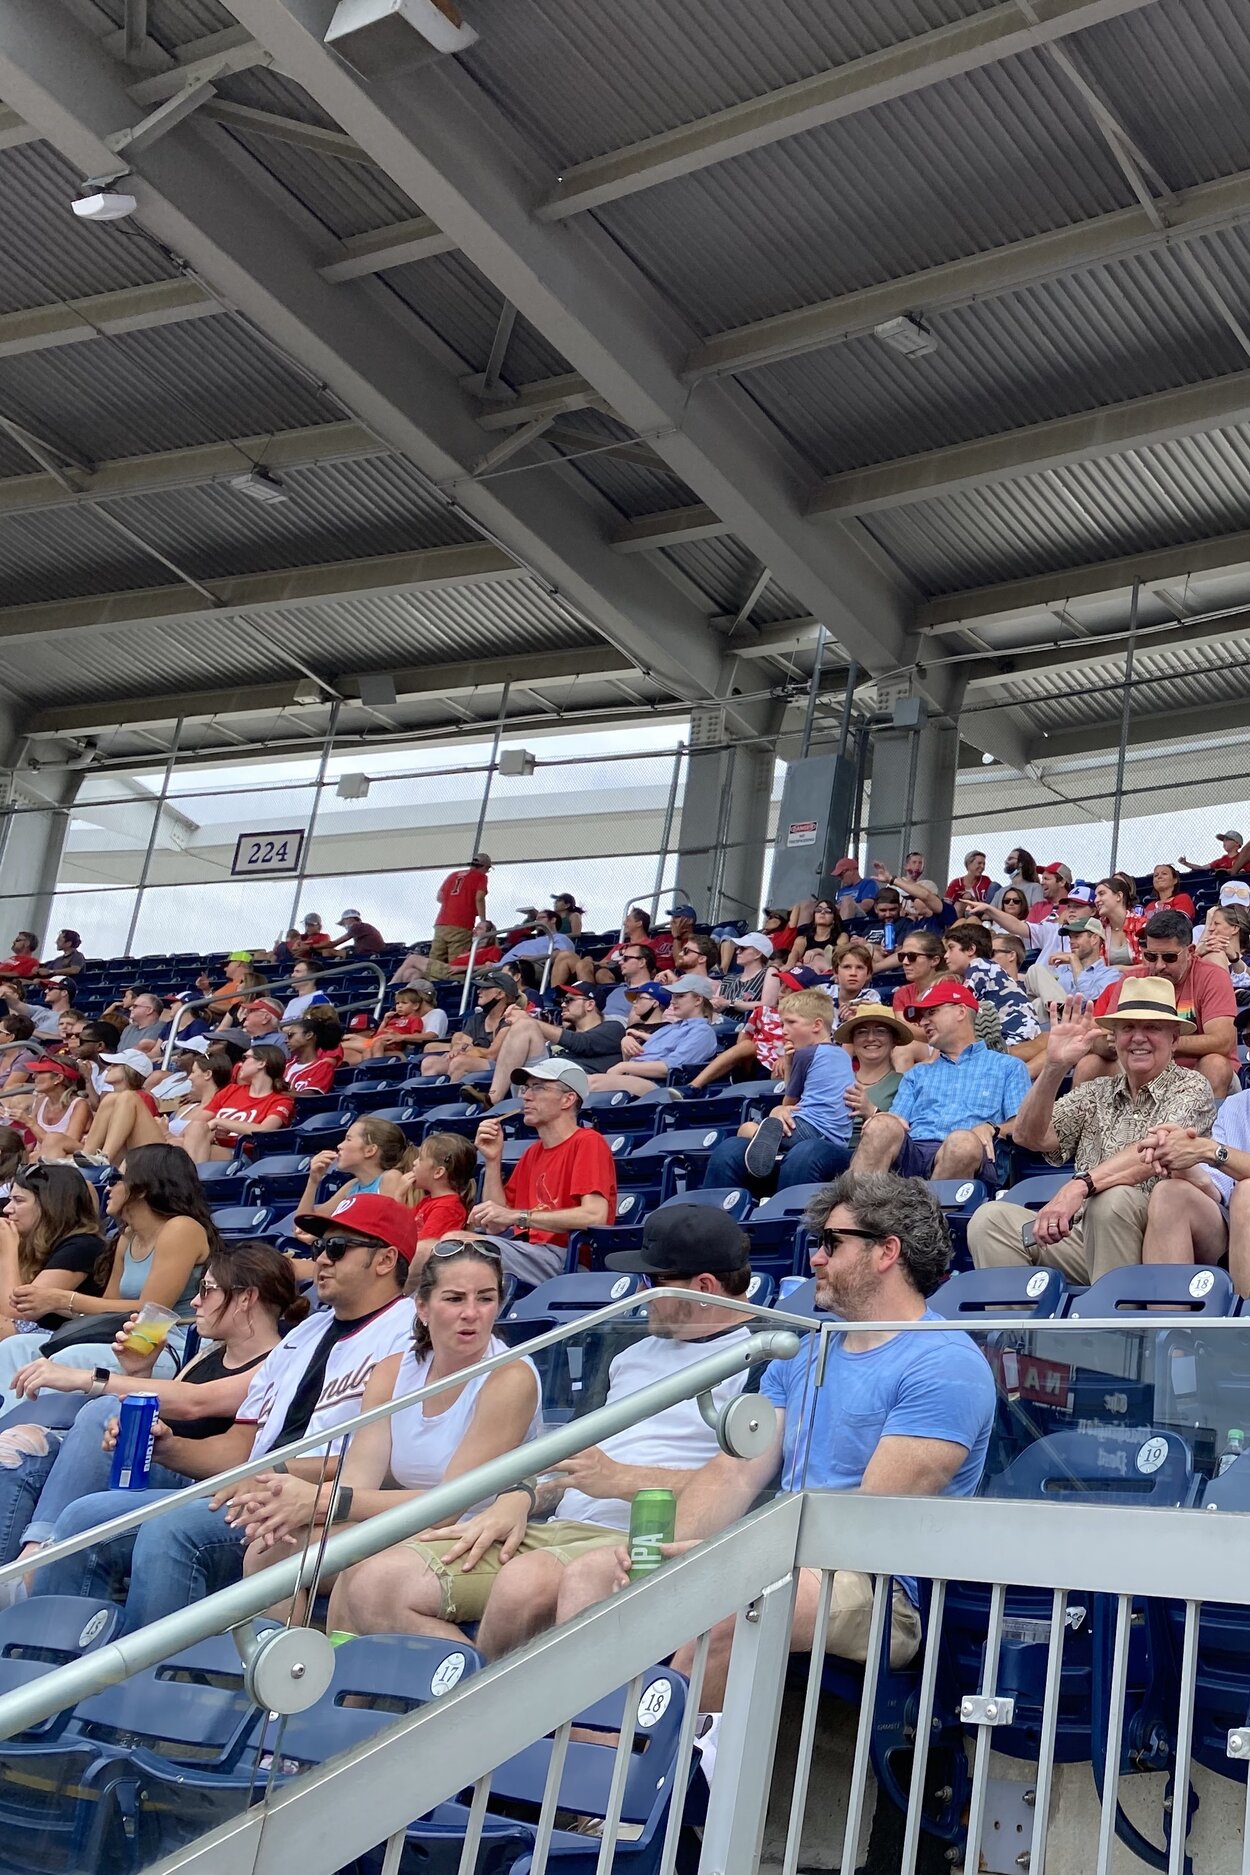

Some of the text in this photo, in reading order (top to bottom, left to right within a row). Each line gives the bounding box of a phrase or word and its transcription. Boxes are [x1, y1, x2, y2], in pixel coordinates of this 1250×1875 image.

[247, 840, 288, 864] 224
[1032, 1278, 1046, 1290] 17
[1194, 1278, 1210, 1290] 18
[1143, 1448, 1163, 1463] 19
[631, 1532, 664, 1570] IPA
[86, 1621, 102, 1635] 15
[438, 1665, 460, 1683] 17
[644, 1693, 665, 1713] 18
